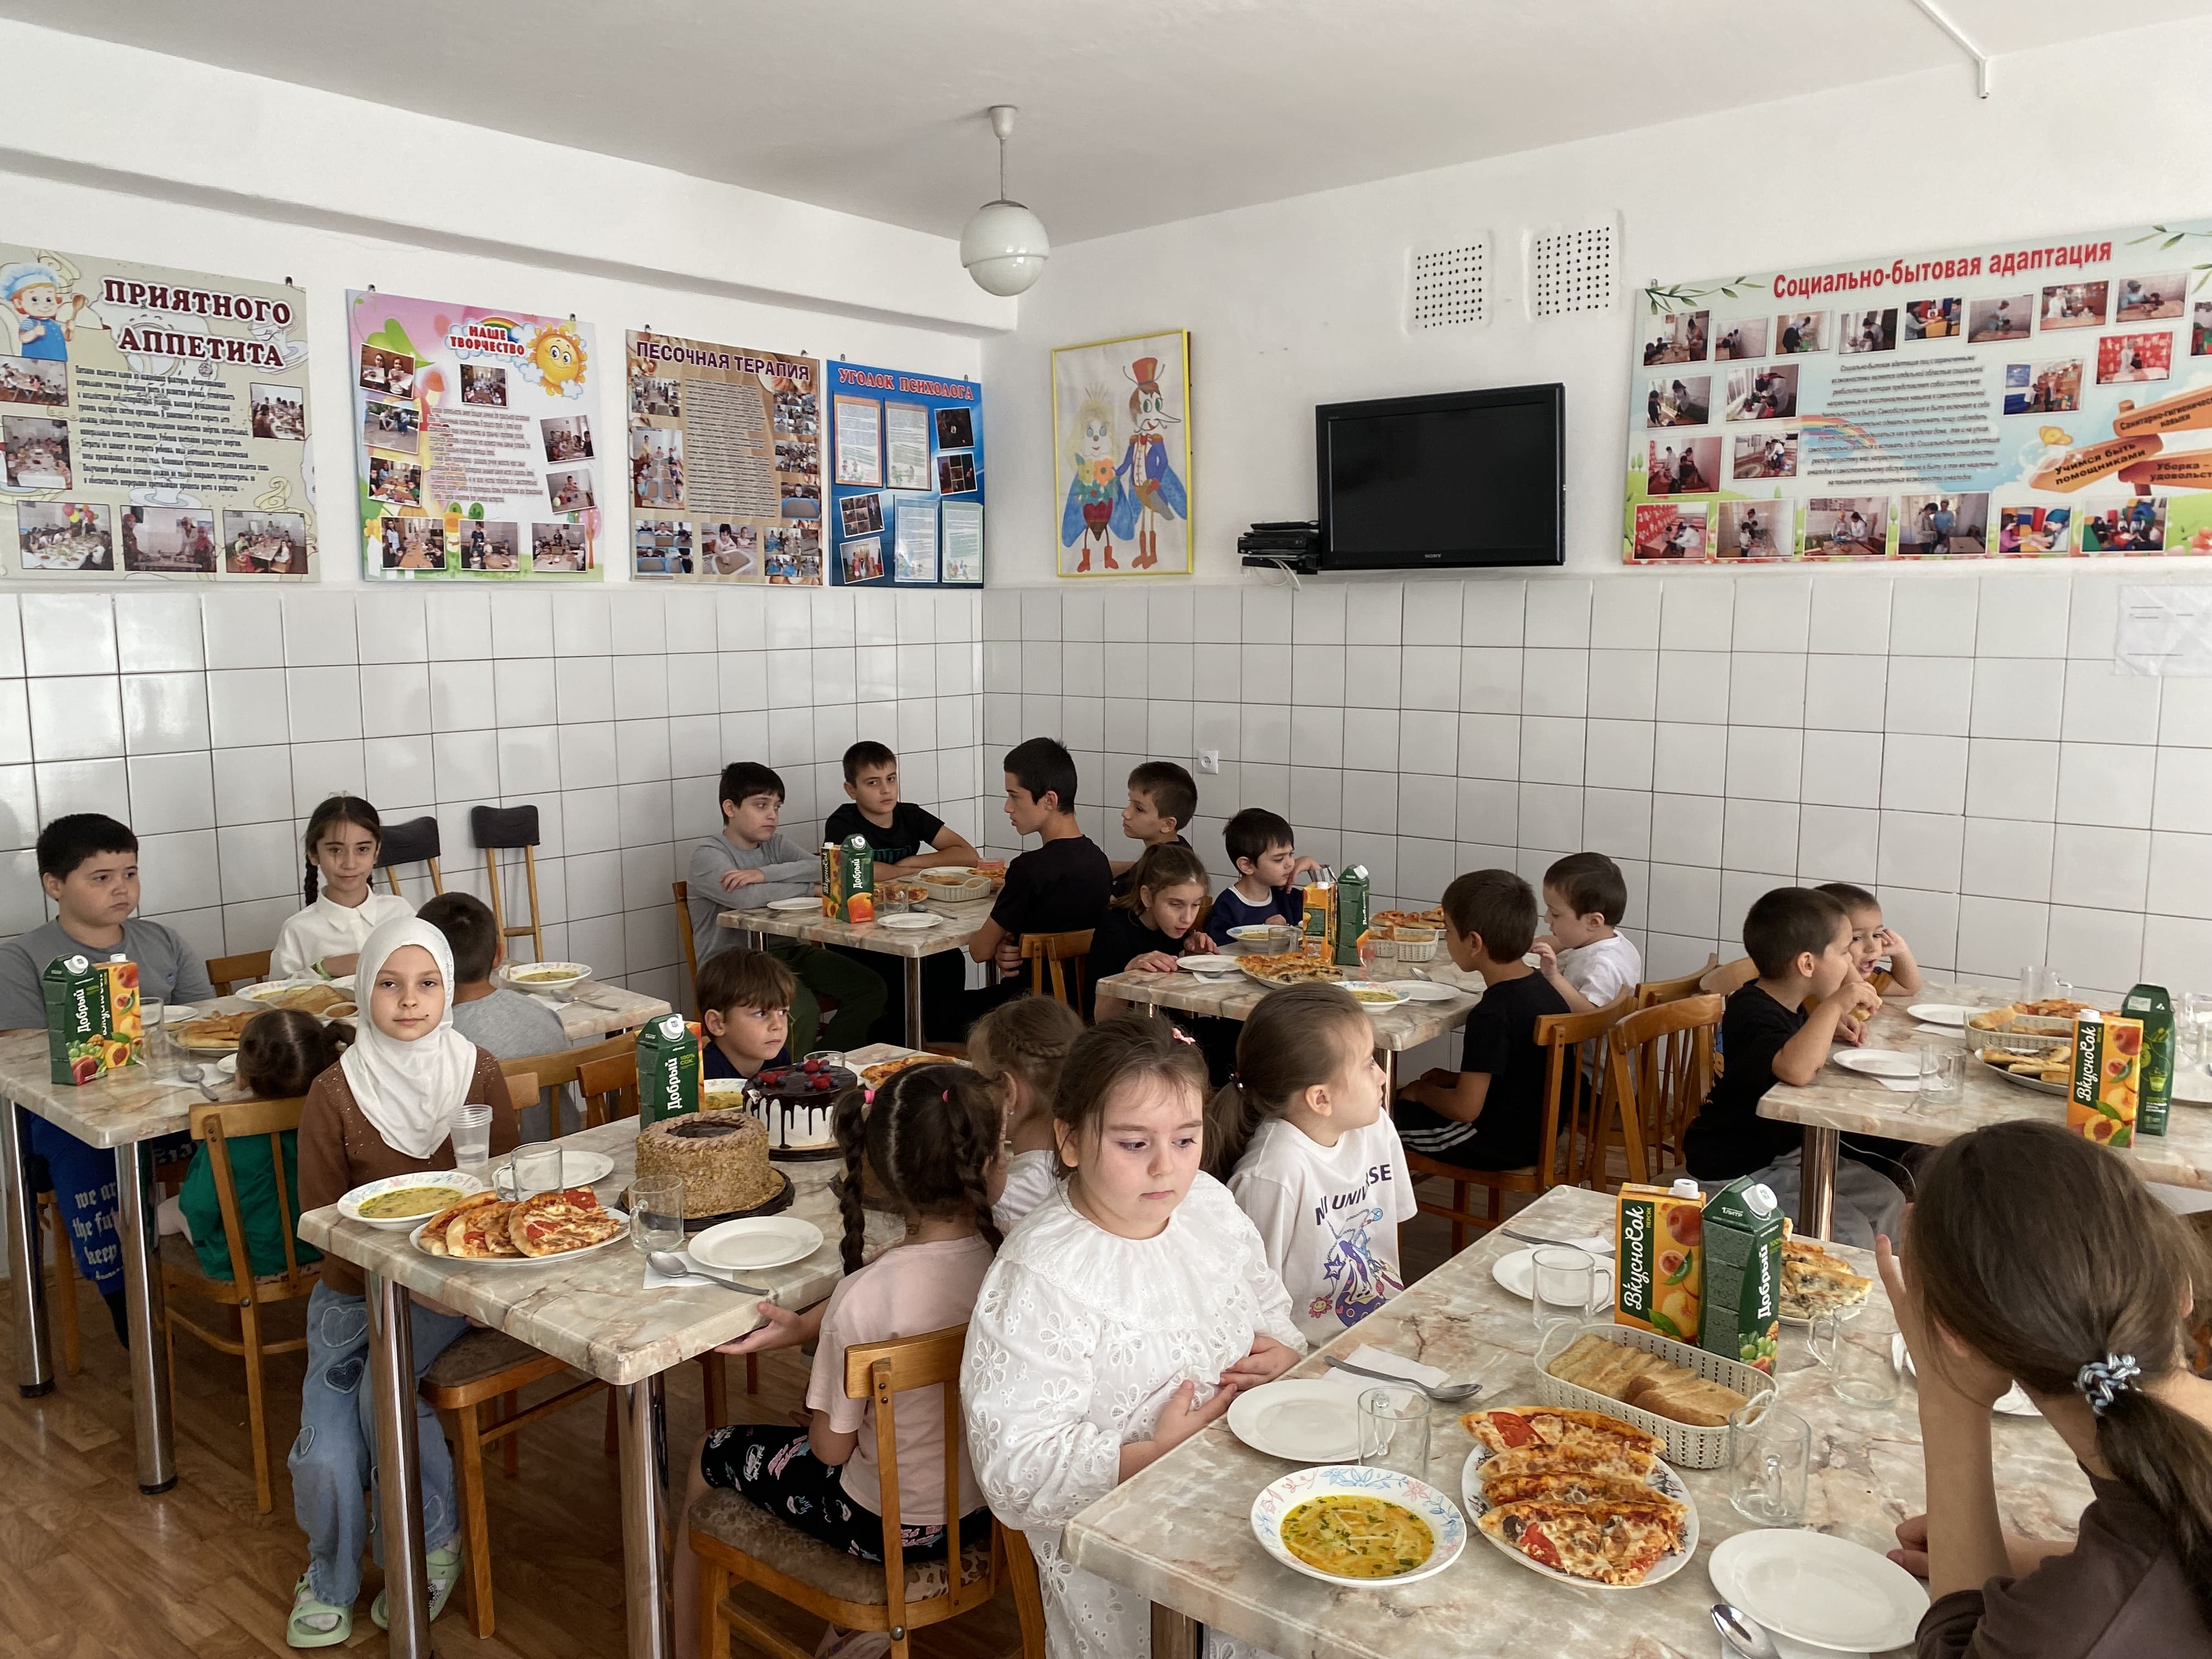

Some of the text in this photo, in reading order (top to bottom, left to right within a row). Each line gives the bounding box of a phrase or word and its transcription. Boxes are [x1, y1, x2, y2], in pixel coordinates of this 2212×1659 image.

[1773, 241, 2112, 300] Социально-бытовая адаптация
[103, 279, 291, 324] ПРИЯТНОГО
[119, 328, 285, 366] АППЕТИТА
[450, 336, 526, 356] ТВОРЧЕСТВО
[469, 325, 507, 341] НАШЕ
[636, 341, 810, 381] ПЕСОЧНАЯ ТЕРАПИЯ
[838, 368, 974, 401] УГОЛОК ПСИХОЛОГА
[2120, 397, 2212, 430] Санитарно-гигиеничес
[2056, 449, 2146, 485] помощниками
[851, 859, 863, 889] Добрый
[74, 988, 91, 1033] Добрый
[665, 1057, 683, 1110] Добрый
[2076, 1025, 2098, 1102] ВкусноСок
[1623, 1205, 1650, 1311] ВкусноСок
[1758, 1244, 1772, 1319] Добрый
